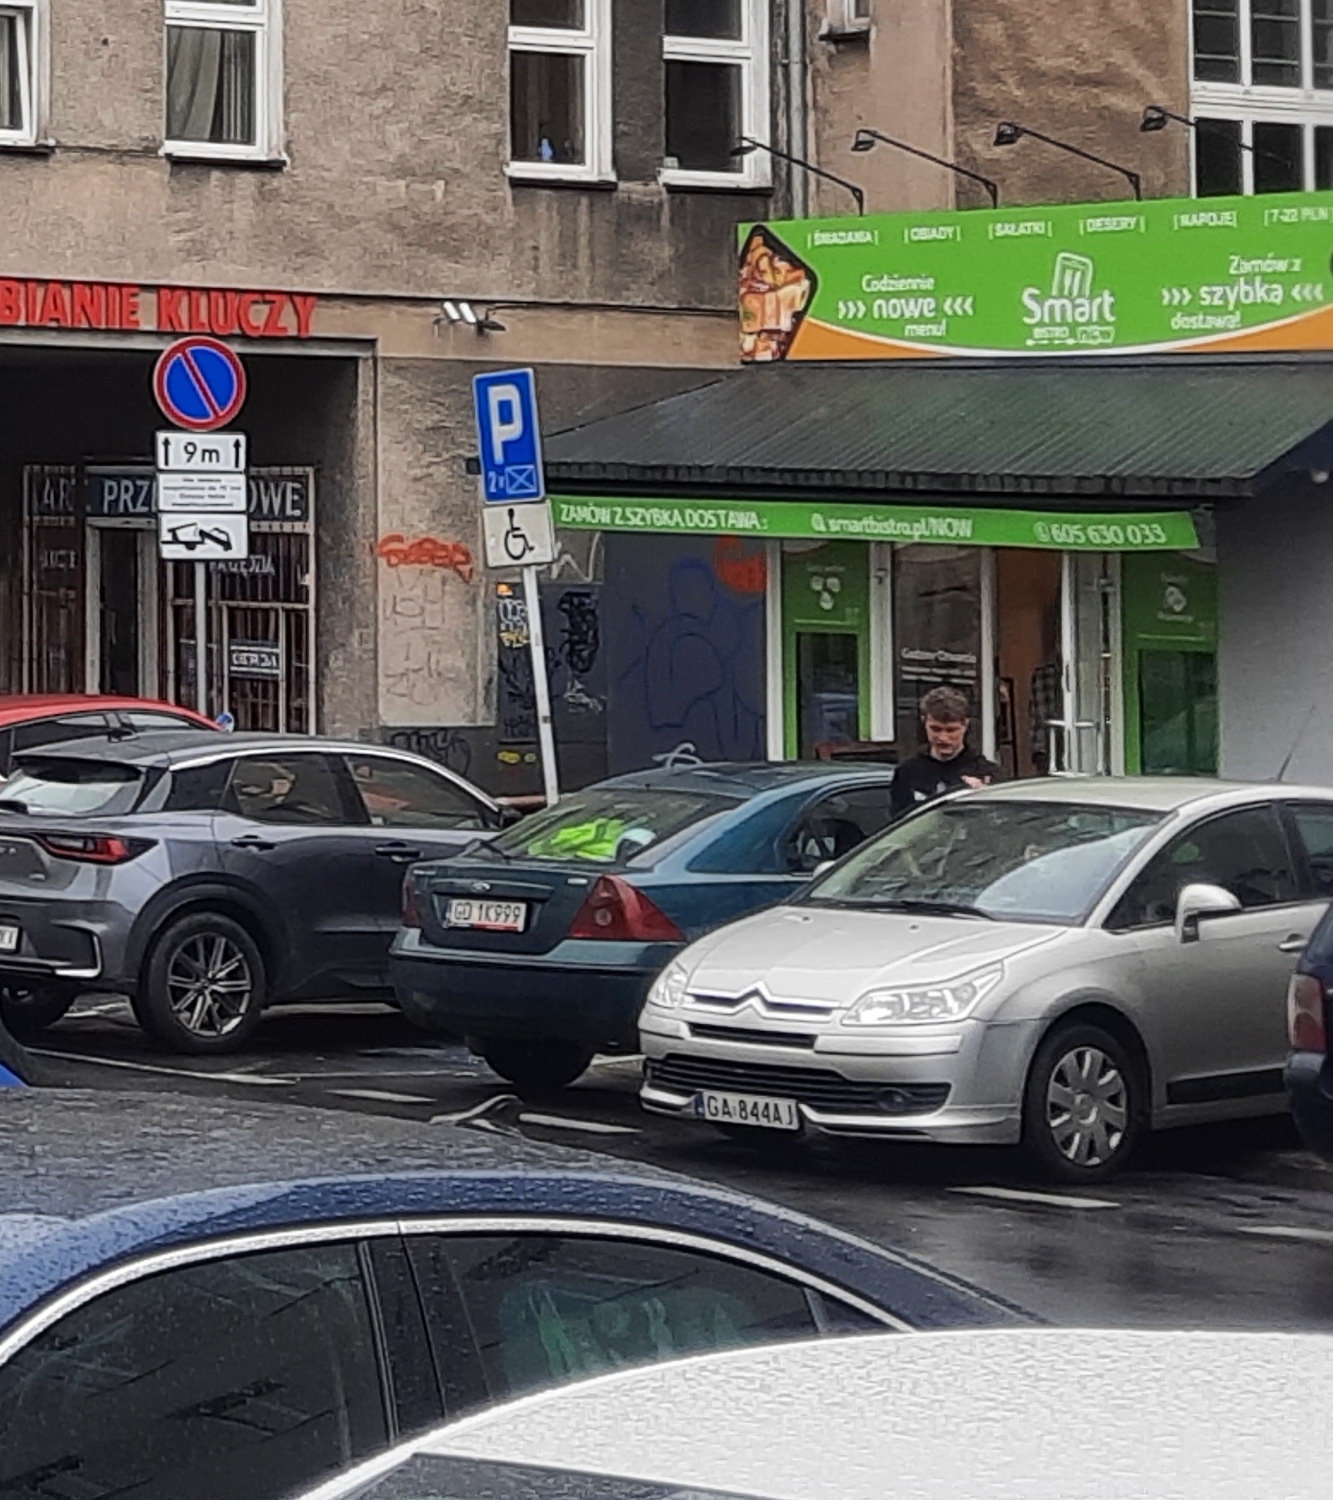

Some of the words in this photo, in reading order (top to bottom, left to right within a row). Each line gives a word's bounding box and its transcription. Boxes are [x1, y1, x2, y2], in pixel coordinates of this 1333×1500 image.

[157, 288, 318, 338] KLUCZY
[872, 297, 936, 319] nowe
[1022, 286, 1117, 325] Smart
[487, 383, 524, 465] P
[183, 441, 198, 463] 9
[200, 446, 221, 464] m
[706, 1094, 733, 1119] GA
[738, 1099, 793, 1126] 844AJ
